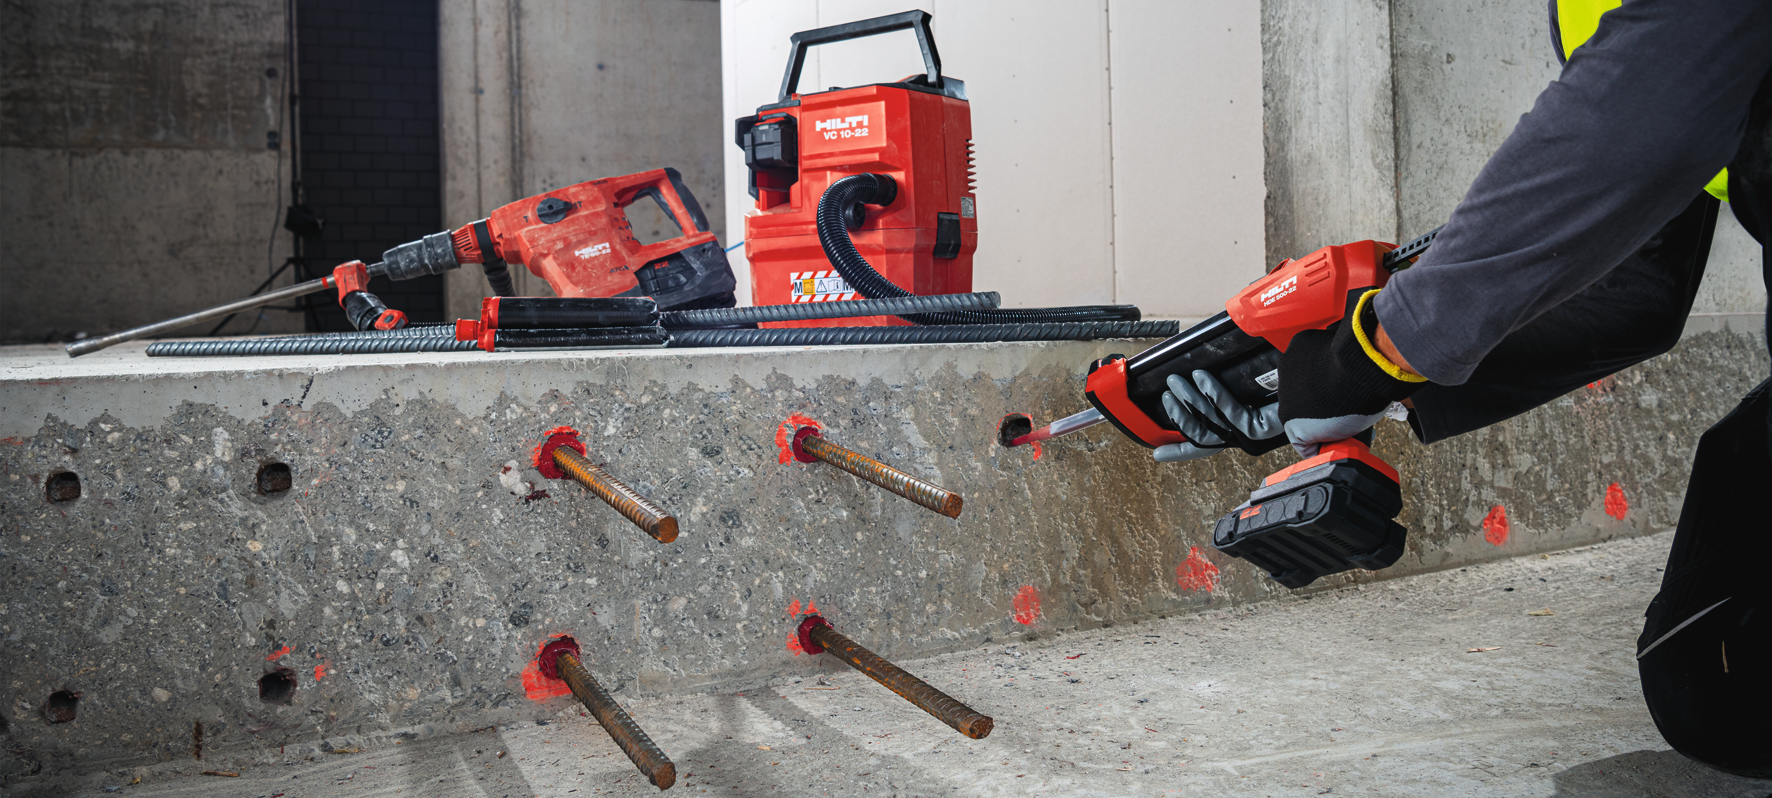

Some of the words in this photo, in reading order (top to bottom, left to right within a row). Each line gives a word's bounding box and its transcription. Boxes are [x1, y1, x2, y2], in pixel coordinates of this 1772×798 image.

[816, 115, 868, 131] HILTI
[824, 131, 837, 140] VC
[840, 128, 868, 138] 10-22
[575, 242, 609, 256] HILTI
[655, 261, 669, 270] 22
[794, 281, 802, 293] M
[1261, 275, 1297, 303] HILTI
[1264, 296, 1276, 307] HDE
[1240, 504, 1263, 520] 22
